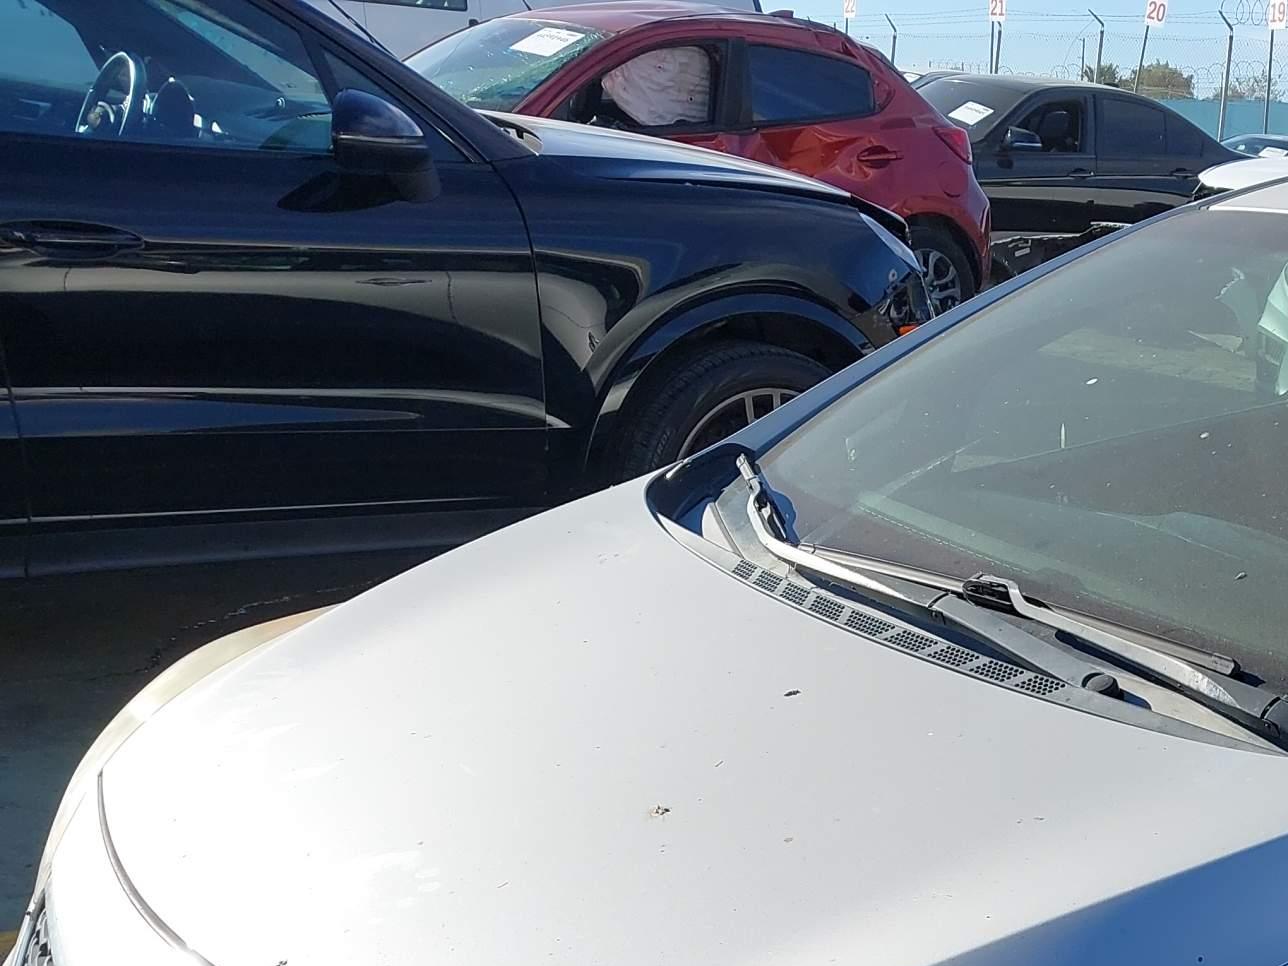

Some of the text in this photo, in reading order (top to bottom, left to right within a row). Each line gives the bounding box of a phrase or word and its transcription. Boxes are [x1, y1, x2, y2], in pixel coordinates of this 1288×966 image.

[990, 0, 1005, 17] 21
[1146, 1, 1166, 22] 20
[1269, 2, 1286, 23] 19
